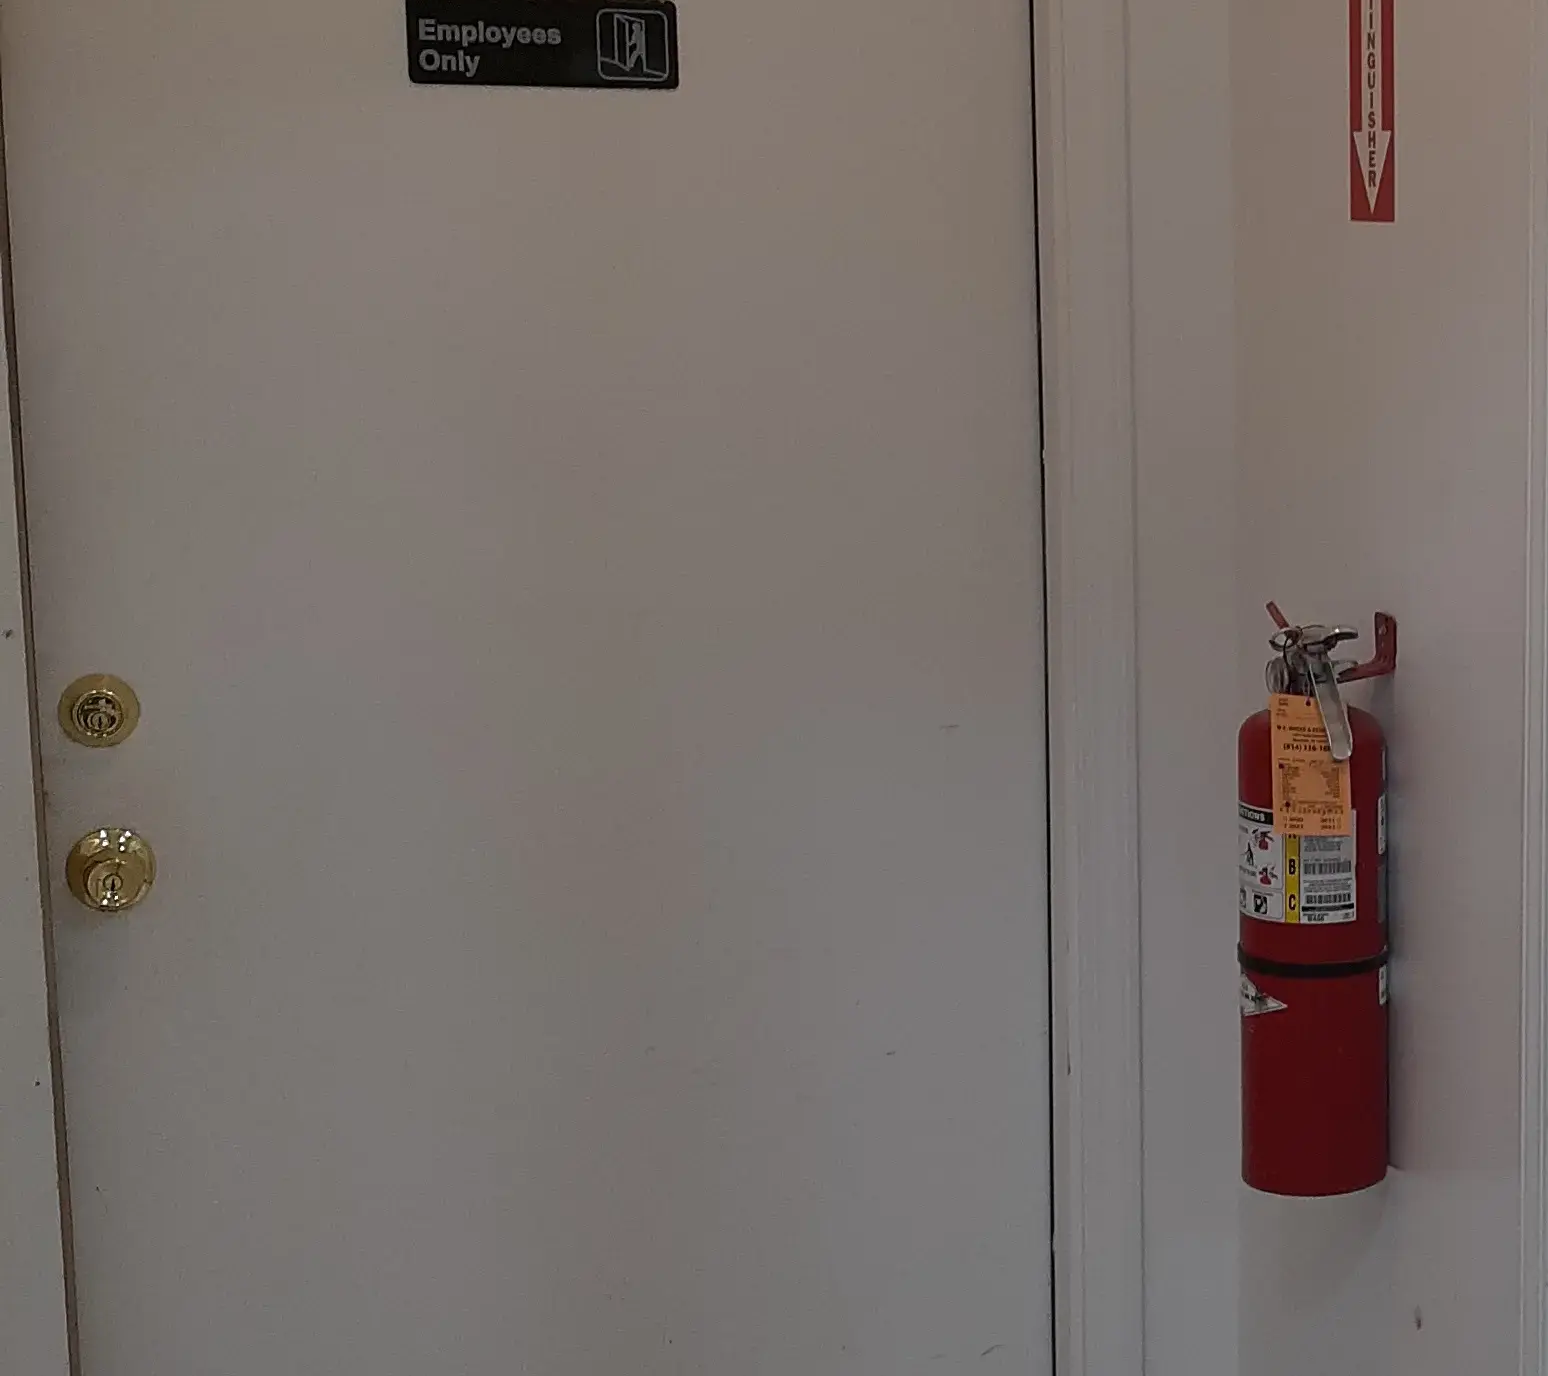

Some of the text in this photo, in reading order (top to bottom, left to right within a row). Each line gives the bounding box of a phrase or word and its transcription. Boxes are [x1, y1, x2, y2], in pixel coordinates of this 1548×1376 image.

[418, 18, 562, 48] Employees
[418, 48, 481, 77] Only
[1288, 858, 1296, 875] B
[1288, 894, 1296, 911] C
